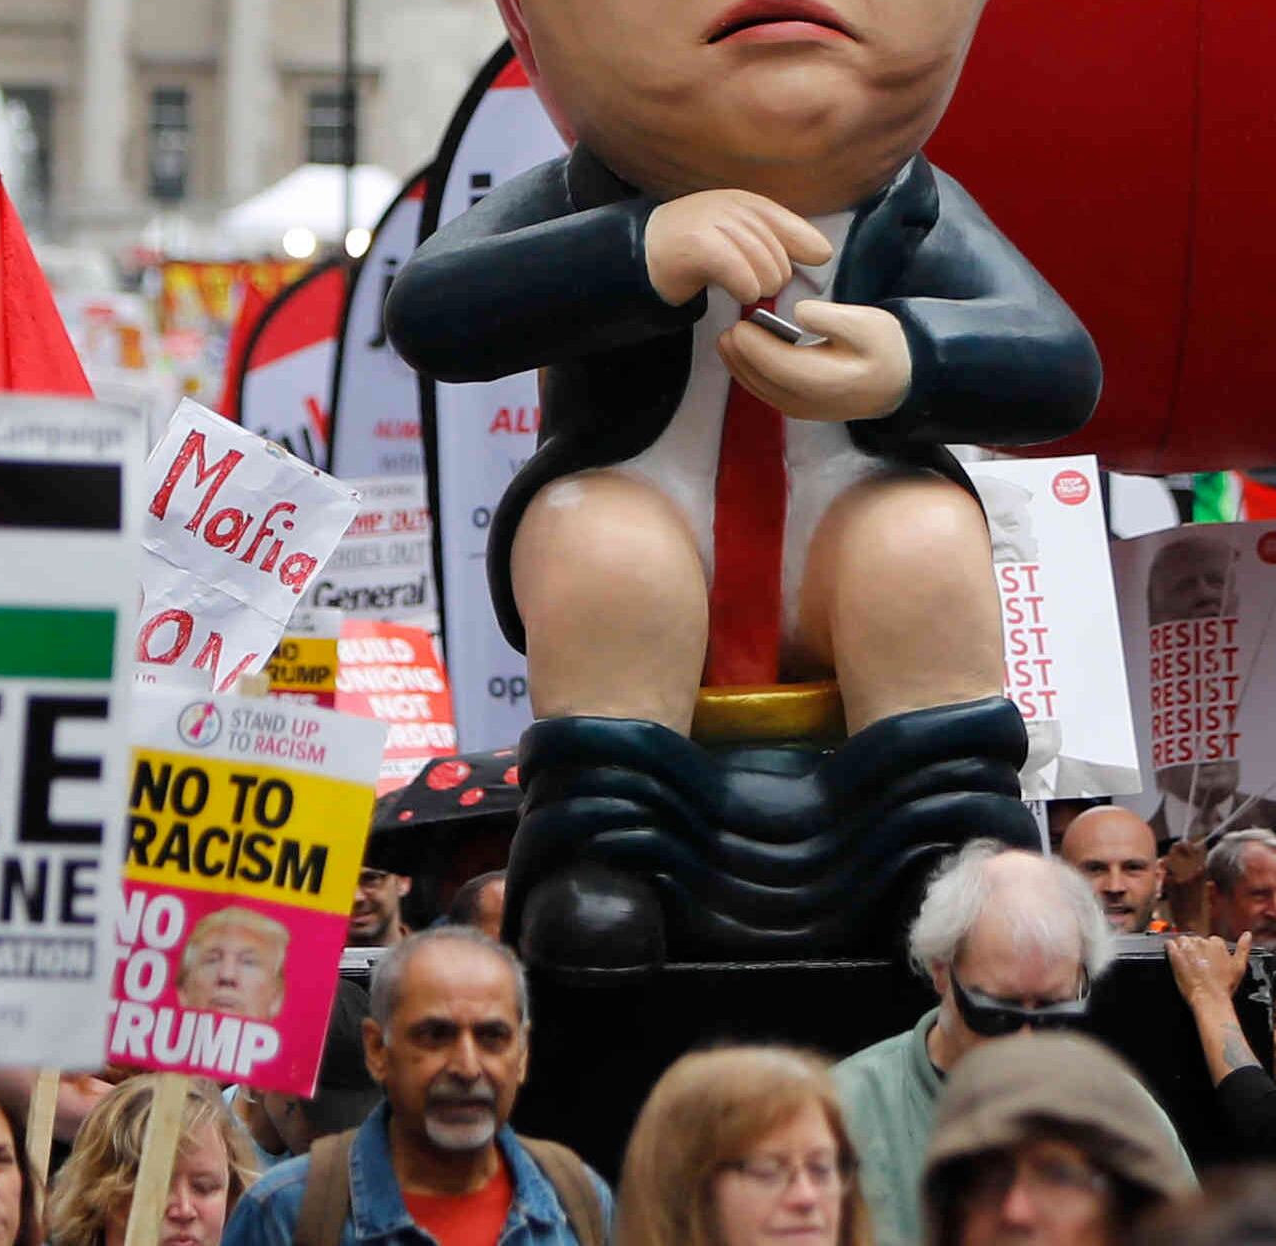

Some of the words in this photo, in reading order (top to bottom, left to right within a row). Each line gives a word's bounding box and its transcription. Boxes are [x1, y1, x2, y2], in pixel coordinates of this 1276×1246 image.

[149, 429, 317, 594] Mafia
[314, 576, 428, 611] General
[336, 639, 416, 664] BUILD
[1150, 619, 1239, 653] RESIST
[1150, 647, 1240, 682] RESIST
[1151, 676, 1241, 711] RESIST
[230, 710, 286, 733] STAND
[292, 718, 321, 741] UP
[1151, 705, 1239, 740] RESIST
[229, 732, 253, 752] TO
[254, 738, 328, 765] RACISM
[128, 760, 210, 817] NO
[228, 774, 294, 829] TO
[124, 816, 329, 894] RACISM
